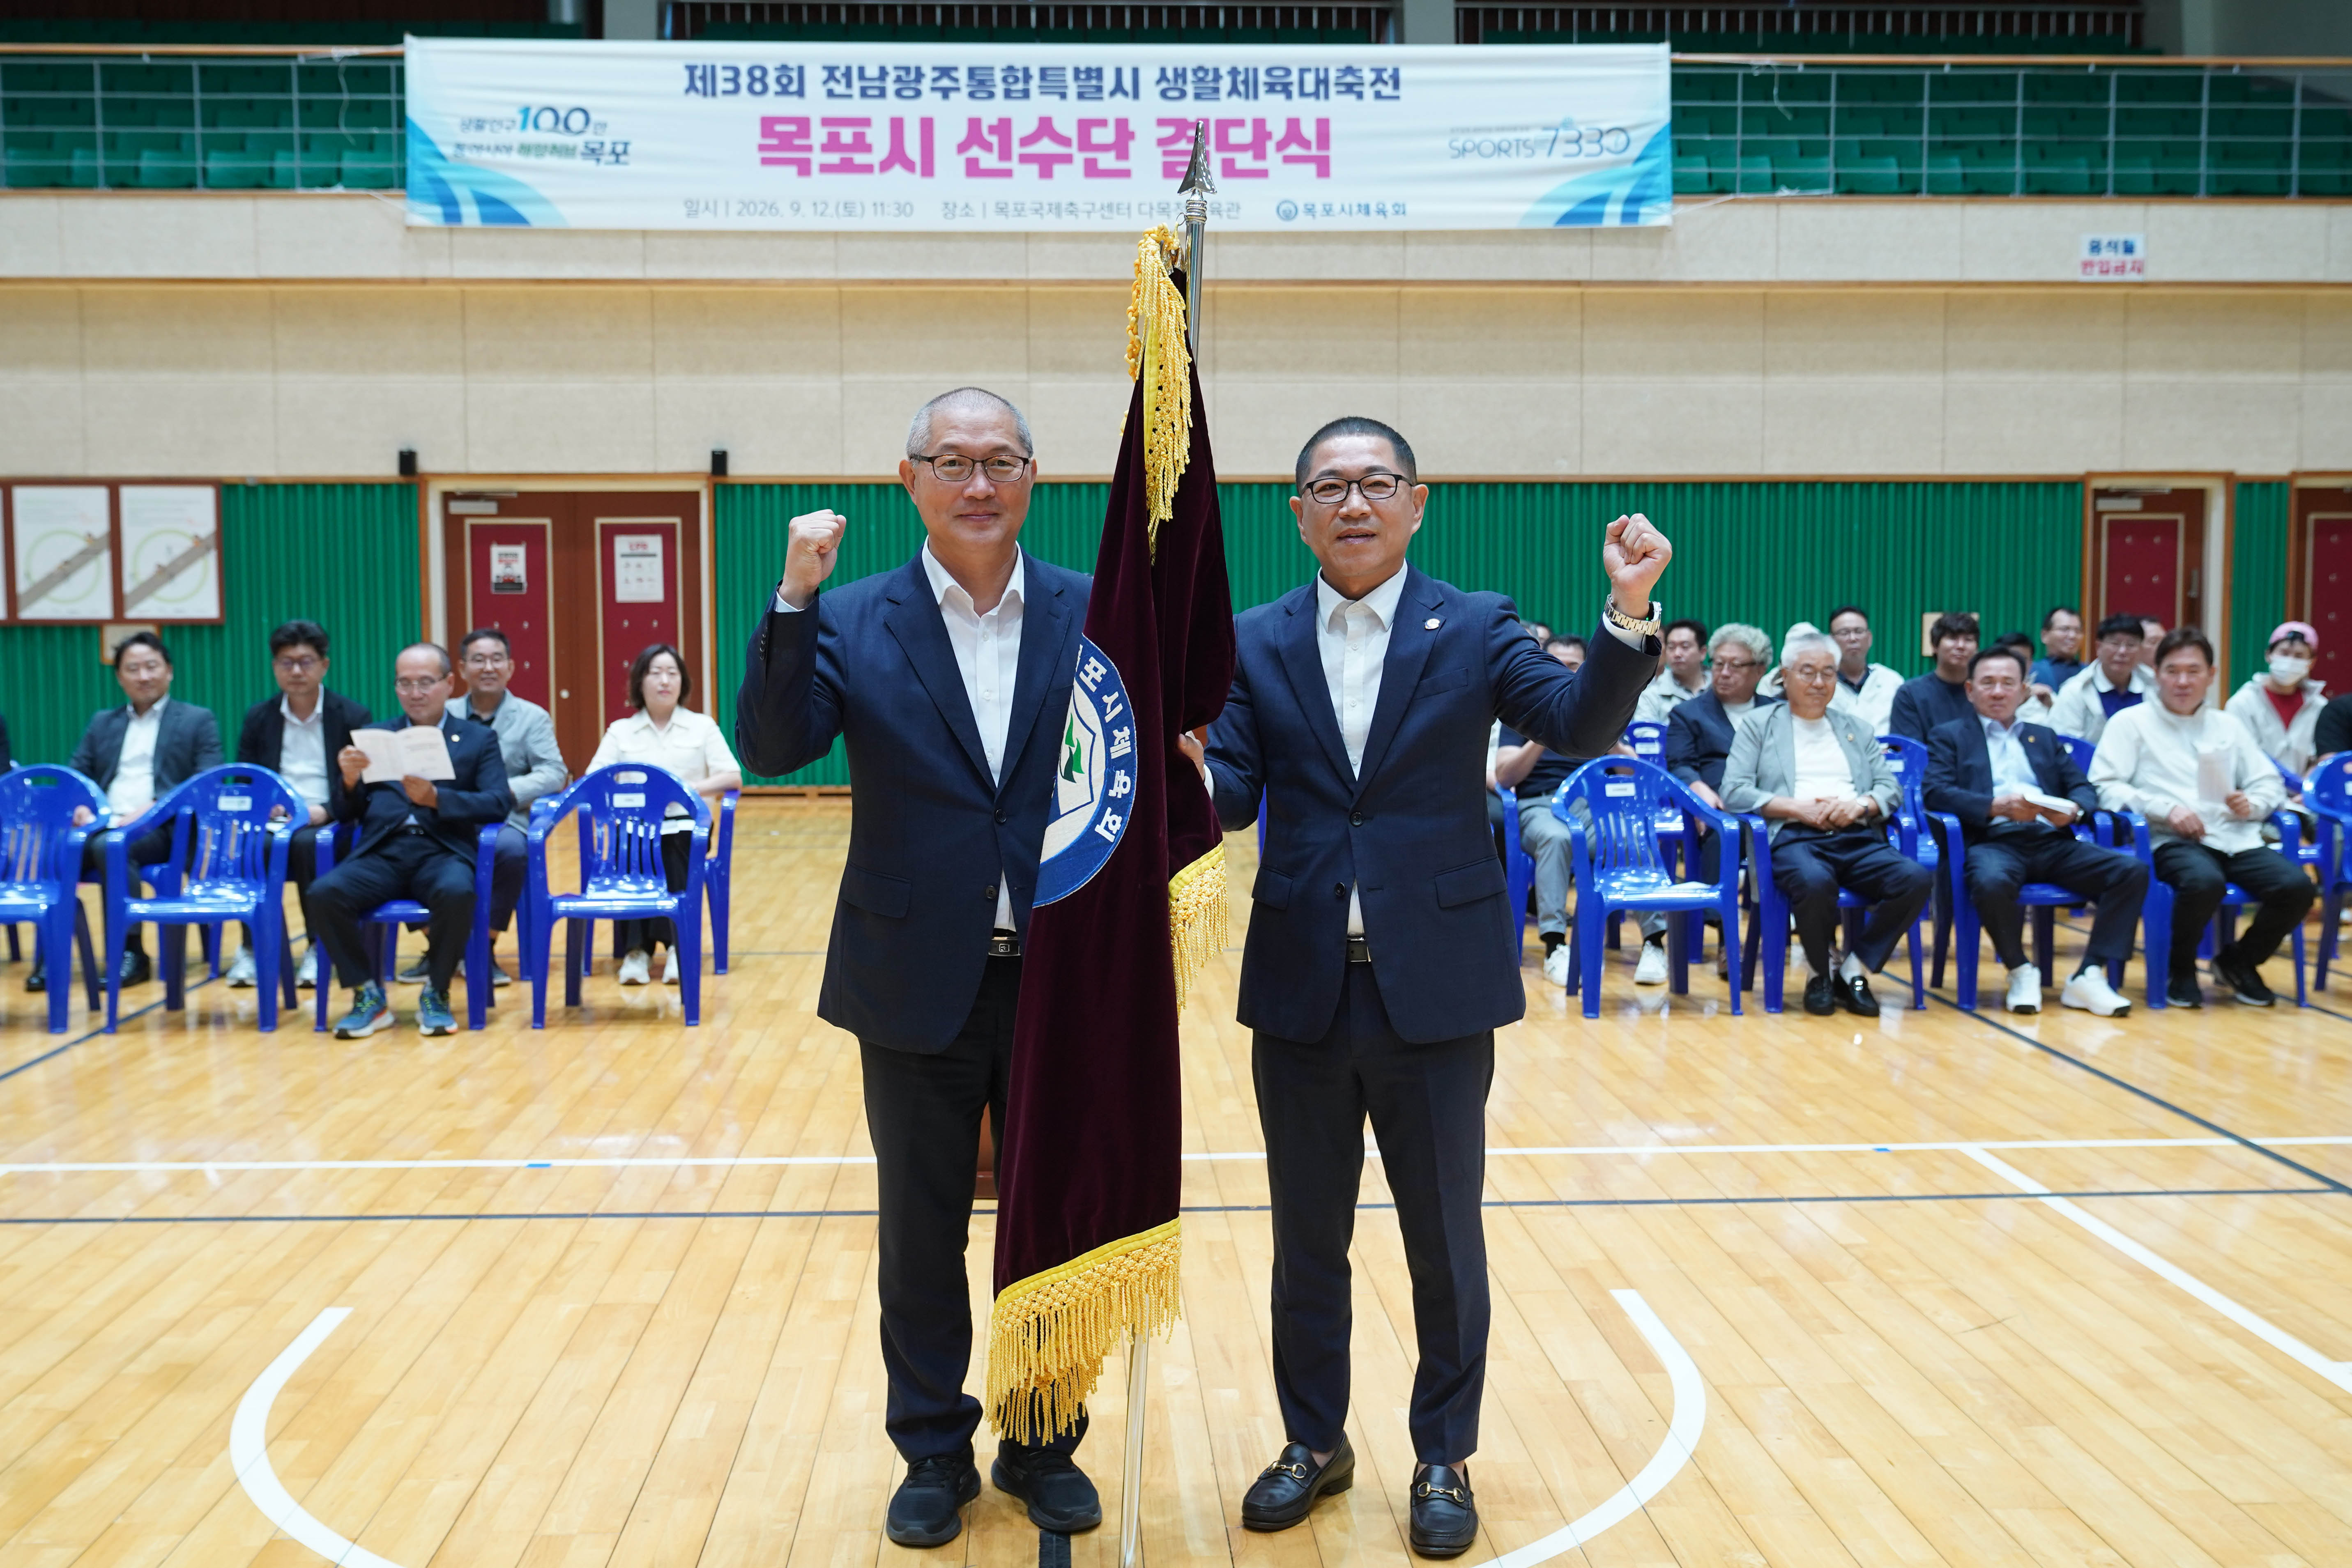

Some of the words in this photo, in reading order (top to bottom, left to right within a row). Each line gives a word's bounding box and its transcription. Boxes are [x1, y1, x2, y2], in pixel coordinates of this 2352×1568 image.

[684, 63, 806, 99] 제38회
[822, 64, 1141, 101] 전남광주통합특별시
[1155, 65, 1402, 102] 생활체육대축전
[580, 140, 632, 166] 목포
[757, 115, 935, 179] 목포시
[957, 116, 1137, 180] 선수단
[1156, 117, 1332, 179] 결단식
[1448, 137, 1535, 159] SPORTS
[683, 198, 718, 219] 일시
[737, 200, 785, 218] 2026.
[872, 201, 915, 218] 11:30
[941, 201, 976, 220] 장소
[994, 200, 1132, 221] 목포국제축구센터
[1137, 200, 1242, 221] 다목육관
[1303, 202, 1406, 219] 목포시체육회
[1076, 644, 1132, 843] 포시체육회
